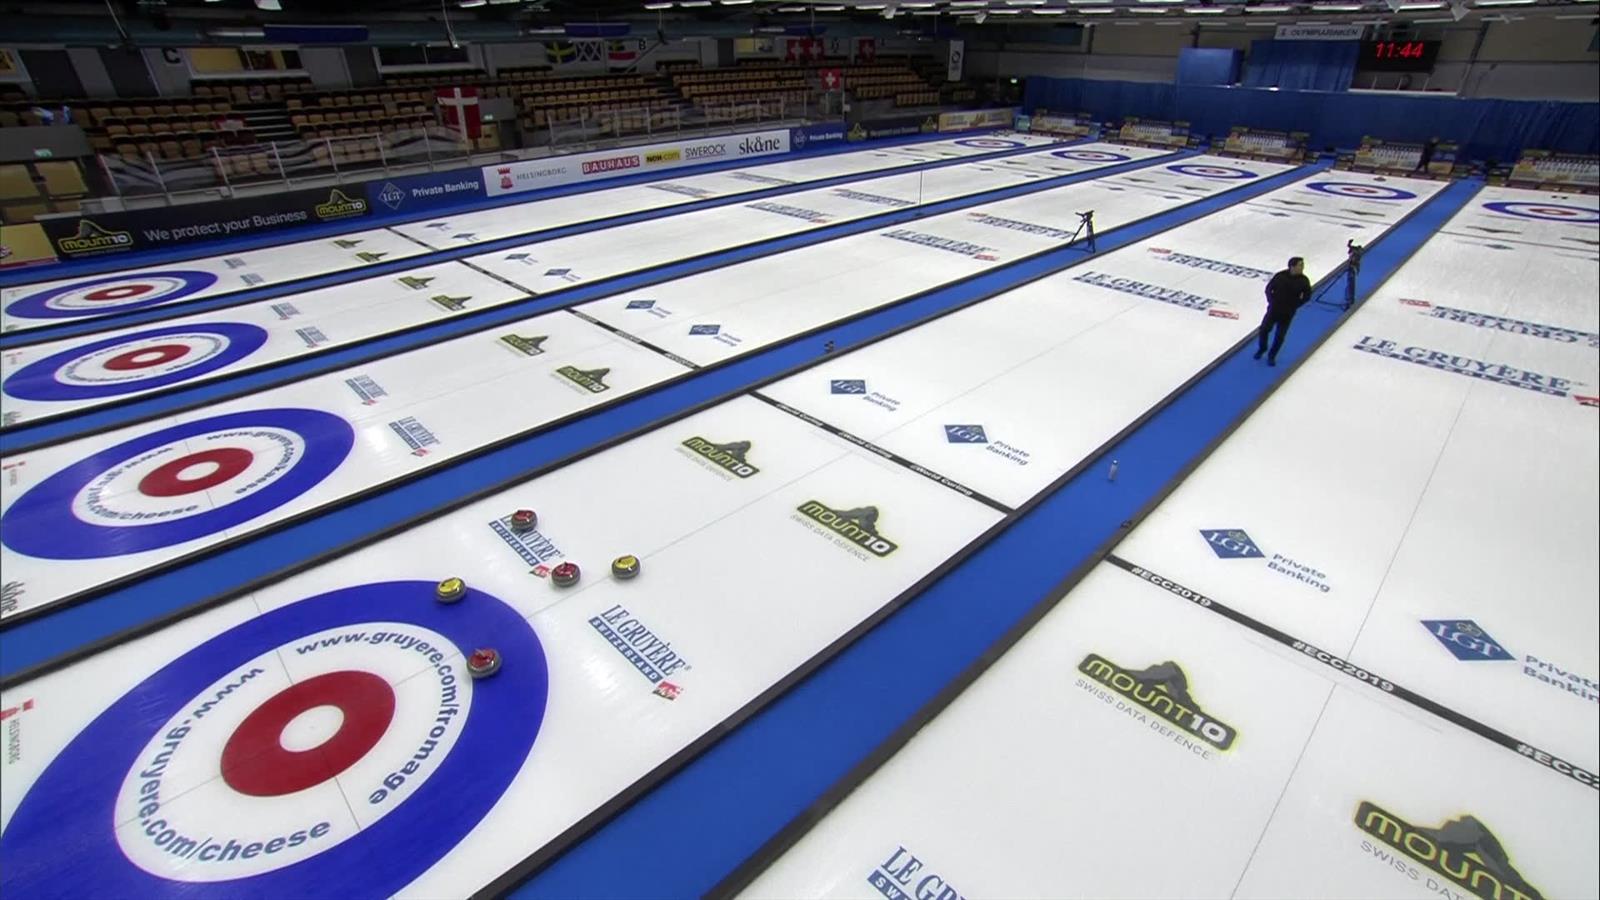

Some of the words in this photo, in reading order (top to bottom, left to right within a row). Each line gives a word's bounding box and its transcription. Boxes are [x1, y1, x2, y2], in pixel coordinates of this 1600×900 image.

[161, 47, 181, 64] C
[1376, 42, 1424, 58] 11:44
[583, 156, 639, 173] BAUHAUS
[685, 144, 726, 158] SWEROCK
[412, 186, 444, 198] Private
[444, 180, 479, 193] Banking
[516, 168, 567, 181] HELSINGBORG
[144, 230, 170, 242] We
[172, 222, 222, 240] protect
[222, 219, 251, 234] your
[253, 210, 307, 228] Business
[1360, 336, 1397, 352] LE
[1404, 346, 1571, 391] GRUYÈRE
[862, 395, 897, 412] Banking
[871, 391, 901, 406] Private
[687, 438, 754, 477] MOUNT10
[985, 445, 1029, 466] Banking
[993, 440, 1030, 458] Private
[940, 478, 974, 497] Curling
[802, 503, 890, 553] MOUNT10
[1209, 532, 1257, 556] LGT
[1267, 561, 1331, 593] Banking
[1272, 553, 1326, 579] Private
[1131, 565, 1212, 607] #ECC2019
[590, 618, 660, 682] SWITZERLAND
[600, 604, 630, 625] LE
[617, 618, 686, 677] GRUYÈRE
[1434, 622, 1501, 658] LGT
[1292, 639, 1395, 693] #ECC2019
[296, 629, 460, 805] www.gruyere.com/fromage
[1086, 659, 1228, 744] MOUNT10
[1074, 678, 1114, 705] SWISS
[1115, 700, 1147, 725] DATA
[1149, 720, 1211, 761] DEFENCE
[139, 667, 332, 862] www.gruyere.com/cheese
[881, 846, 923, 886] LE
[1360, 840, 1420, 881] SWISS
